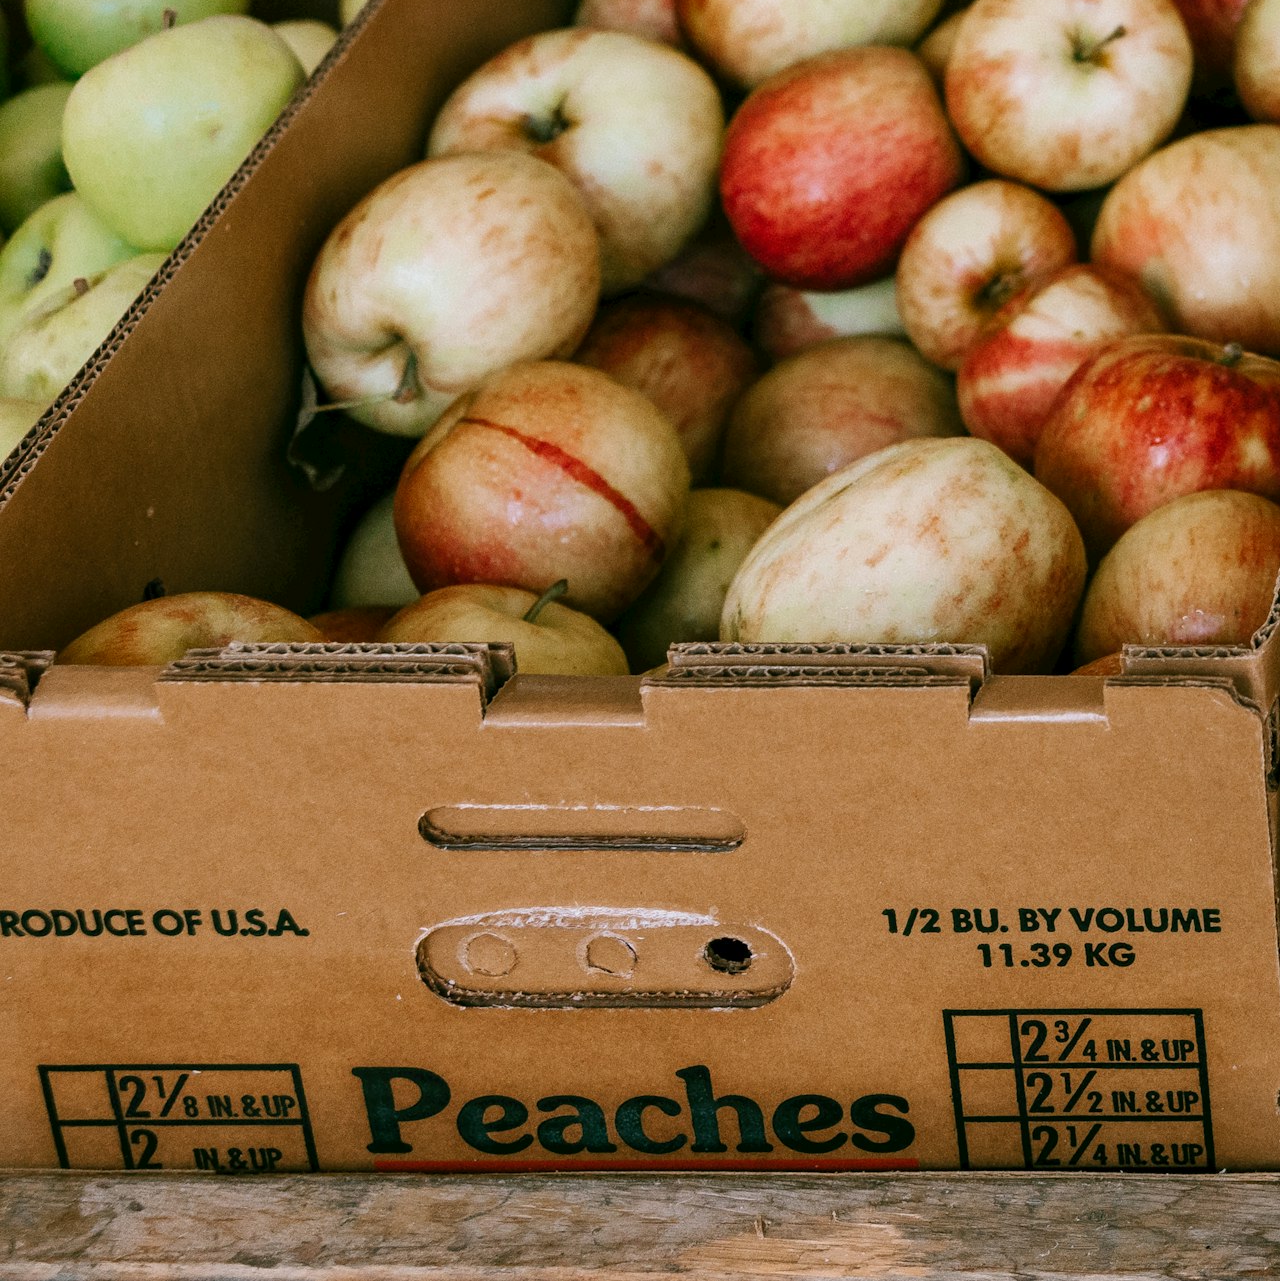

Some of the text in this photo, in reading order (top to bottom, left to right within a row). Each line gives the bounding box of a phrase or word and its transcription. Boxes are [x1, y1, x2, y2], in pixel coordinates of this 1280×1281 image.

[0, 908, 310, 937] RODUCE OF U.S.A.
[882, 907, 1222, 936] 1/2 BU. BY VOLUME
[977, 943, 1136, 968] 11.39 KG
[351, 1064, 916, 1155] Peaches
